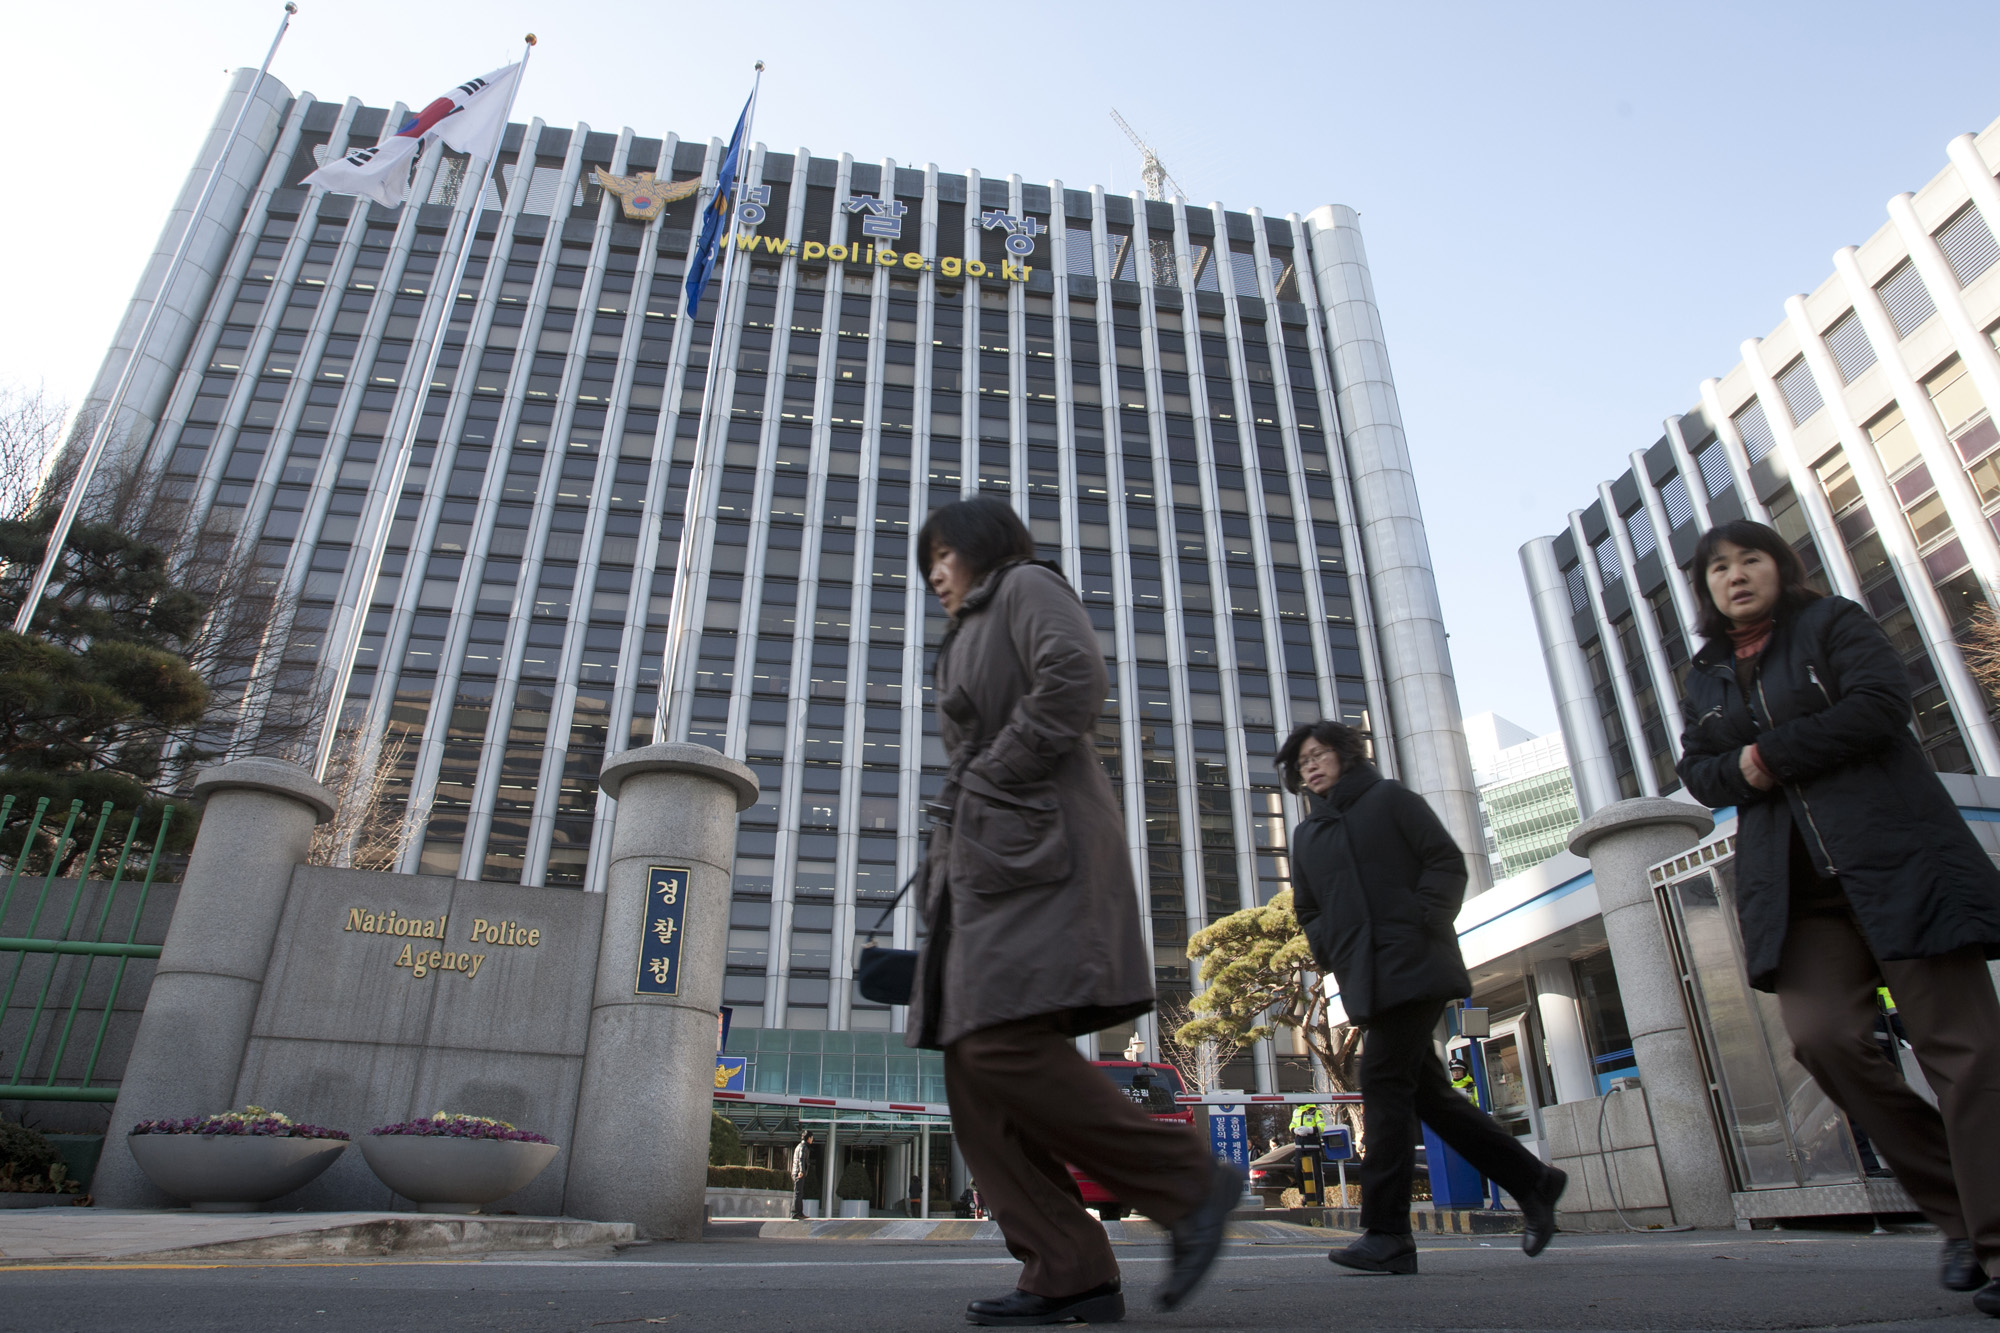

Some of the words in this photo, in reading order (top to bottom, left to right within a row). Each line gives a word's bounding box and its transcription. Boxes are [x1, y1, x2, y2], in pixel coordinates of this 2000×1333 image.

[344, 907, 447, 940] National
[470, 918, 541, 947] Police
[395, 943, 485, 979] Agency
